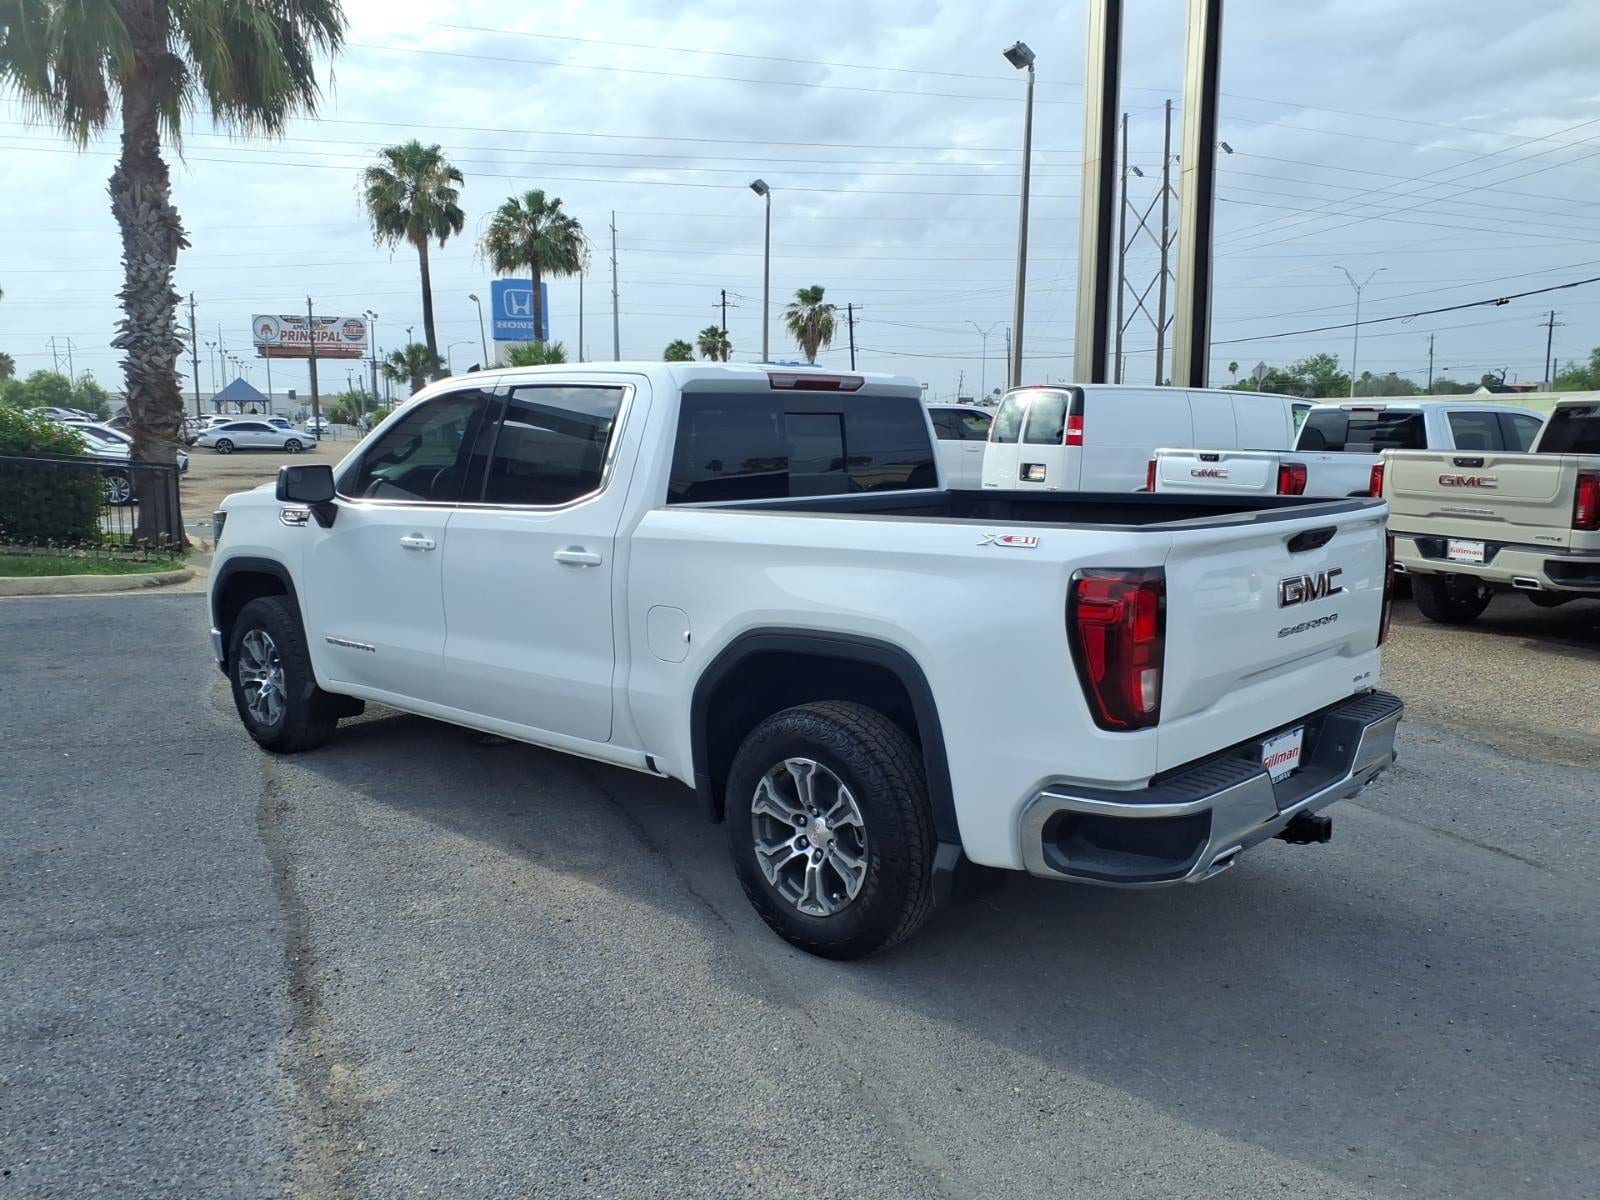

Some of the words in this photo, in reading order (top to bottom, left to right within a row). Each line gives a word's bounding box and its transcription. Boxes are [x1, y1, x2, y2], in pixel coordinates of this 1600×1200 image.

[280, 330, 342, 342] PRINCIPAL
[1190, 469, 1228, 479] GMC
[1438, 474, 1498, 489] GMC
[1278, 568, 1344, 609] GMC
[1278, 613, 1339, 638] SIERRA
[1263, 746, 1300, 769] Gillman
